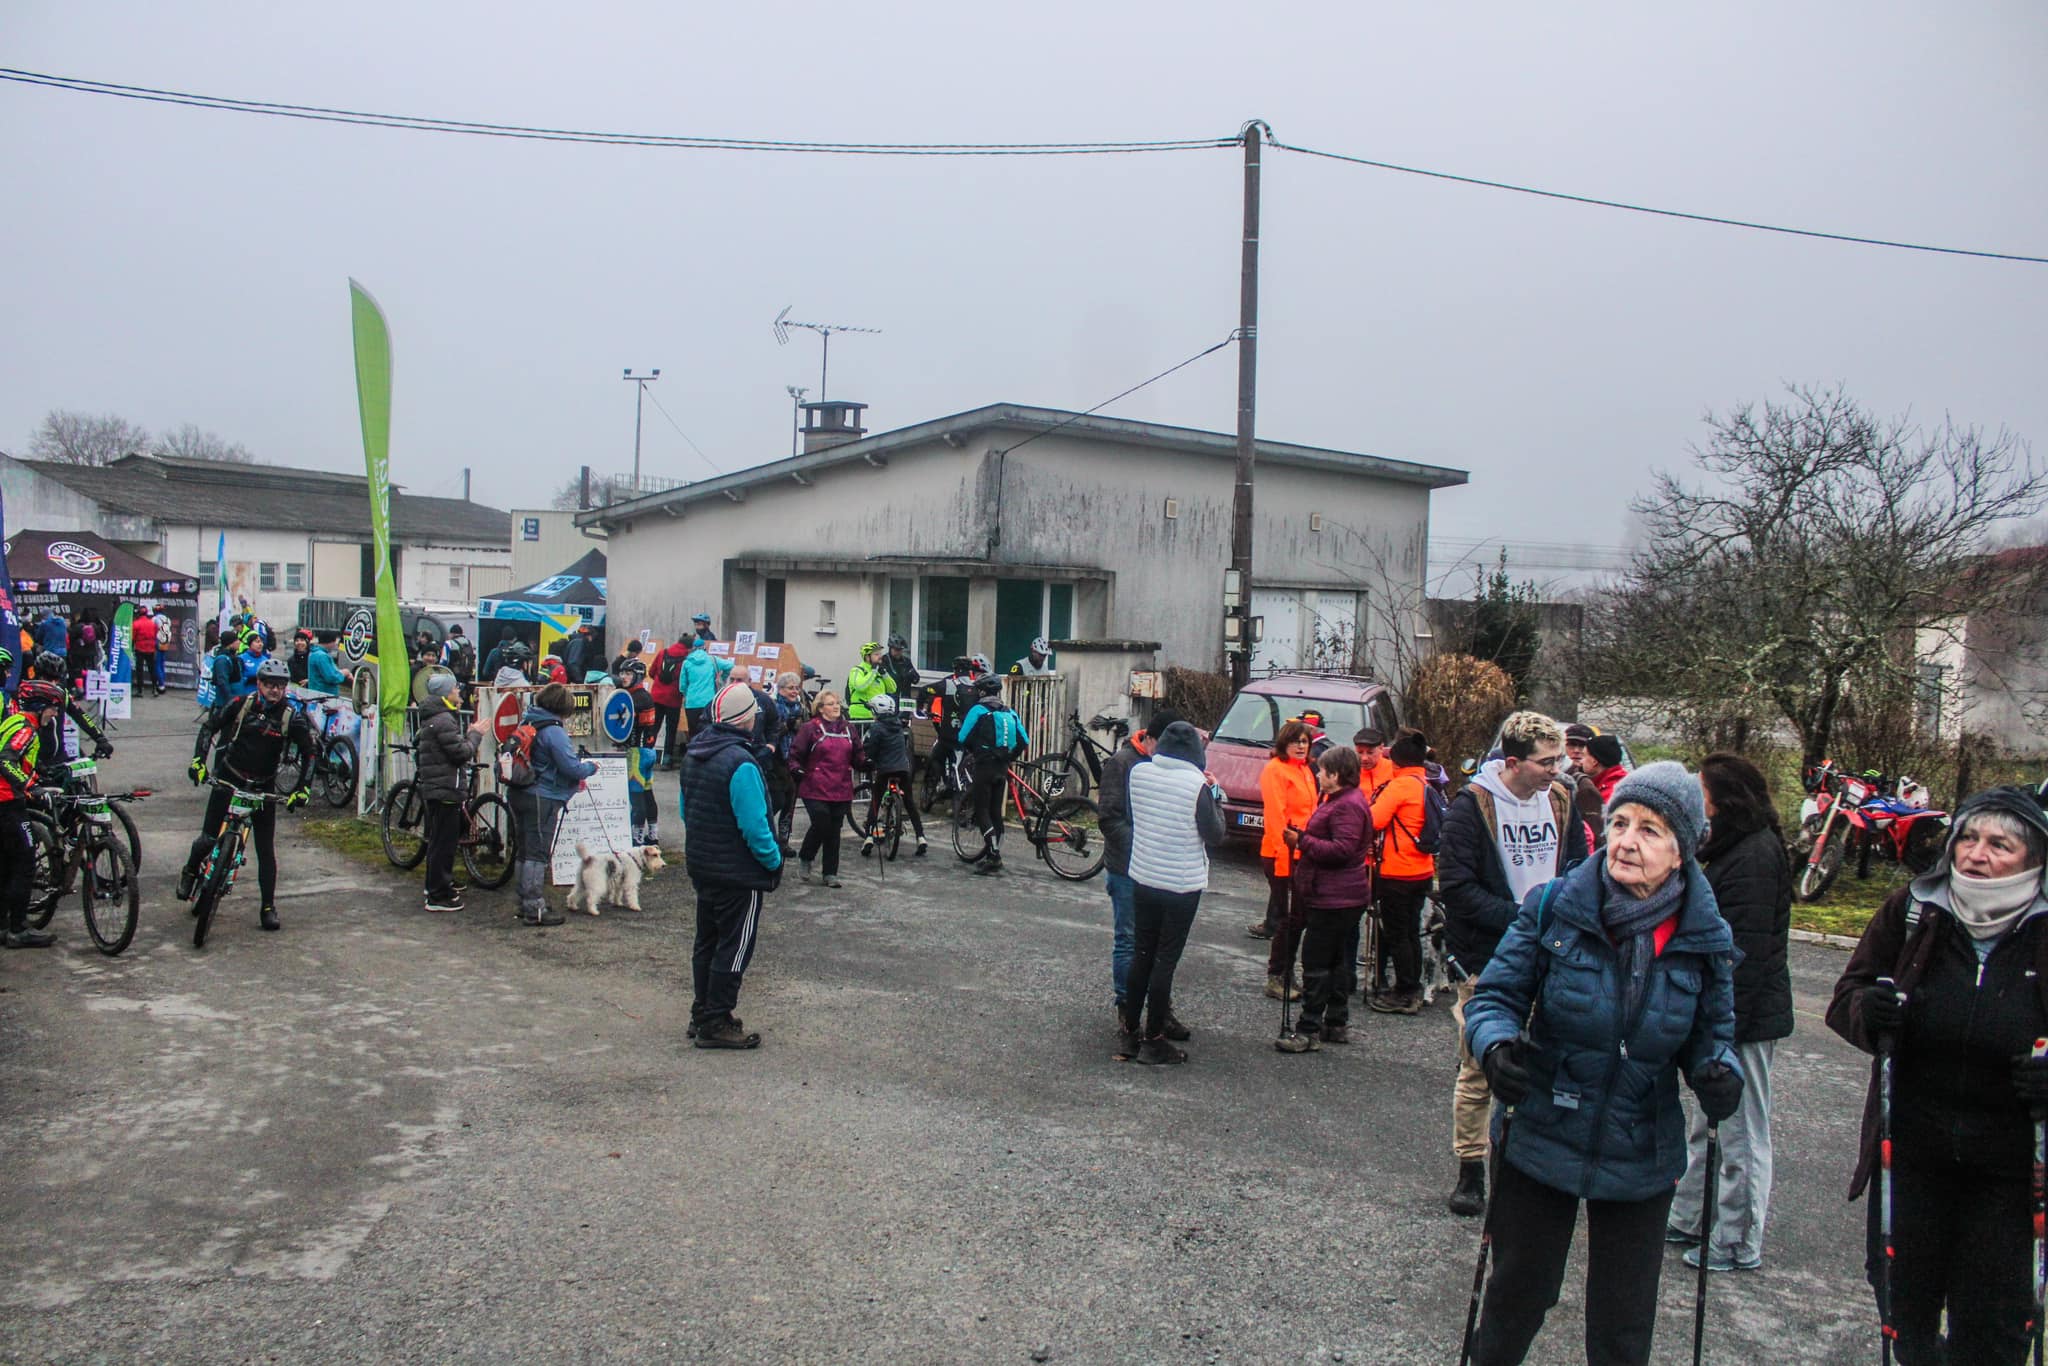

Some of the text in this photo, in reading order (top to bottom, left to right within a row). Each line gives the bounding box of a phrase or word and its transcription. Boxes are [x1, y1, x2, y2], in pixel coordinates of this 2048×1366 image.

[48, 578, 154, 594] VELO CONCEPT 87
[1502, 822, 1557, 843] NASA
